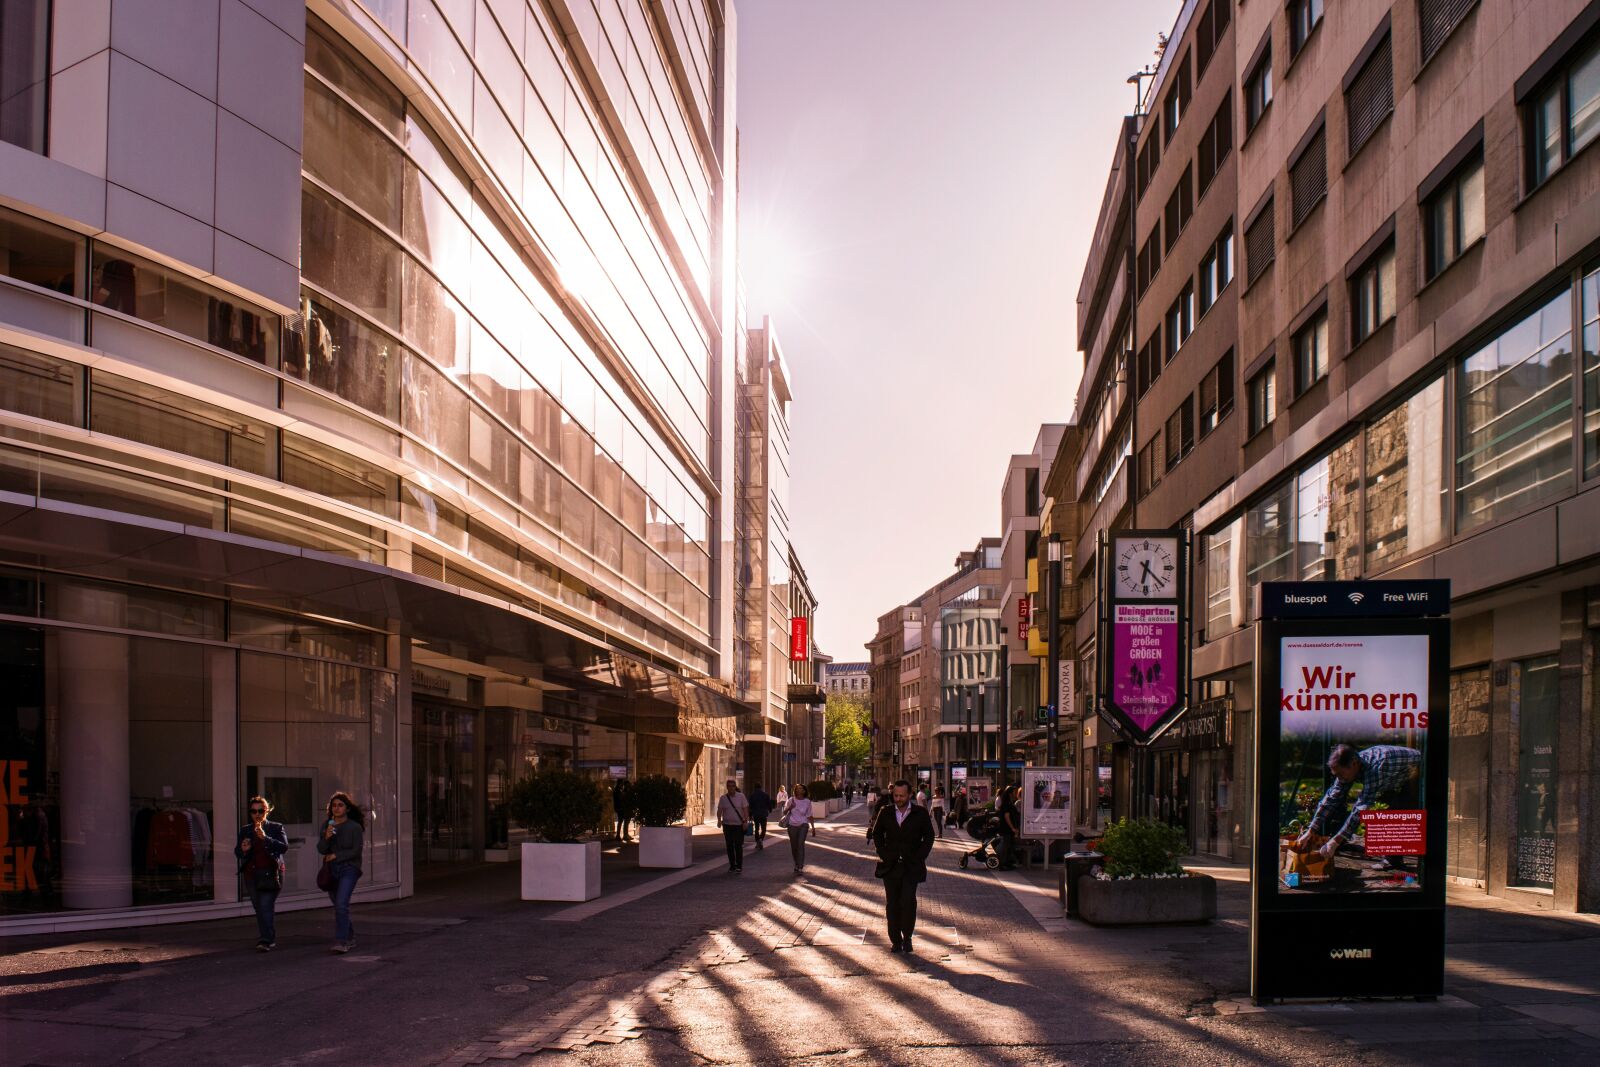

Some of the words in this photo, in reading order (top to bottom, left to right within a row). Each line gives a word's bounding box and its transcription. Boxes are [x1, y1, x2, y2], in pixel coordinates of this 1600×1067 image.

[1284, 594, 1327, 605] bluespot
[1383, 593, 1404, 601] Free
[1406, 592, 1428, 601] WiFi
[1130, 625, 1154, 636] MODE
[1155, 626, 1163, 636] in
[1132, 636, 1160, 647] großen
[1301, 665, 1356, 689] Wir
[1062, 663, 1070, 712] PANDORA
[1280, 688, 1418, 712] kümmern
[1380, 711, 1429, 729] uns
[1376, 812, 1422, 821] Versorgung
[1343, 948, 1372, 959] Wall
